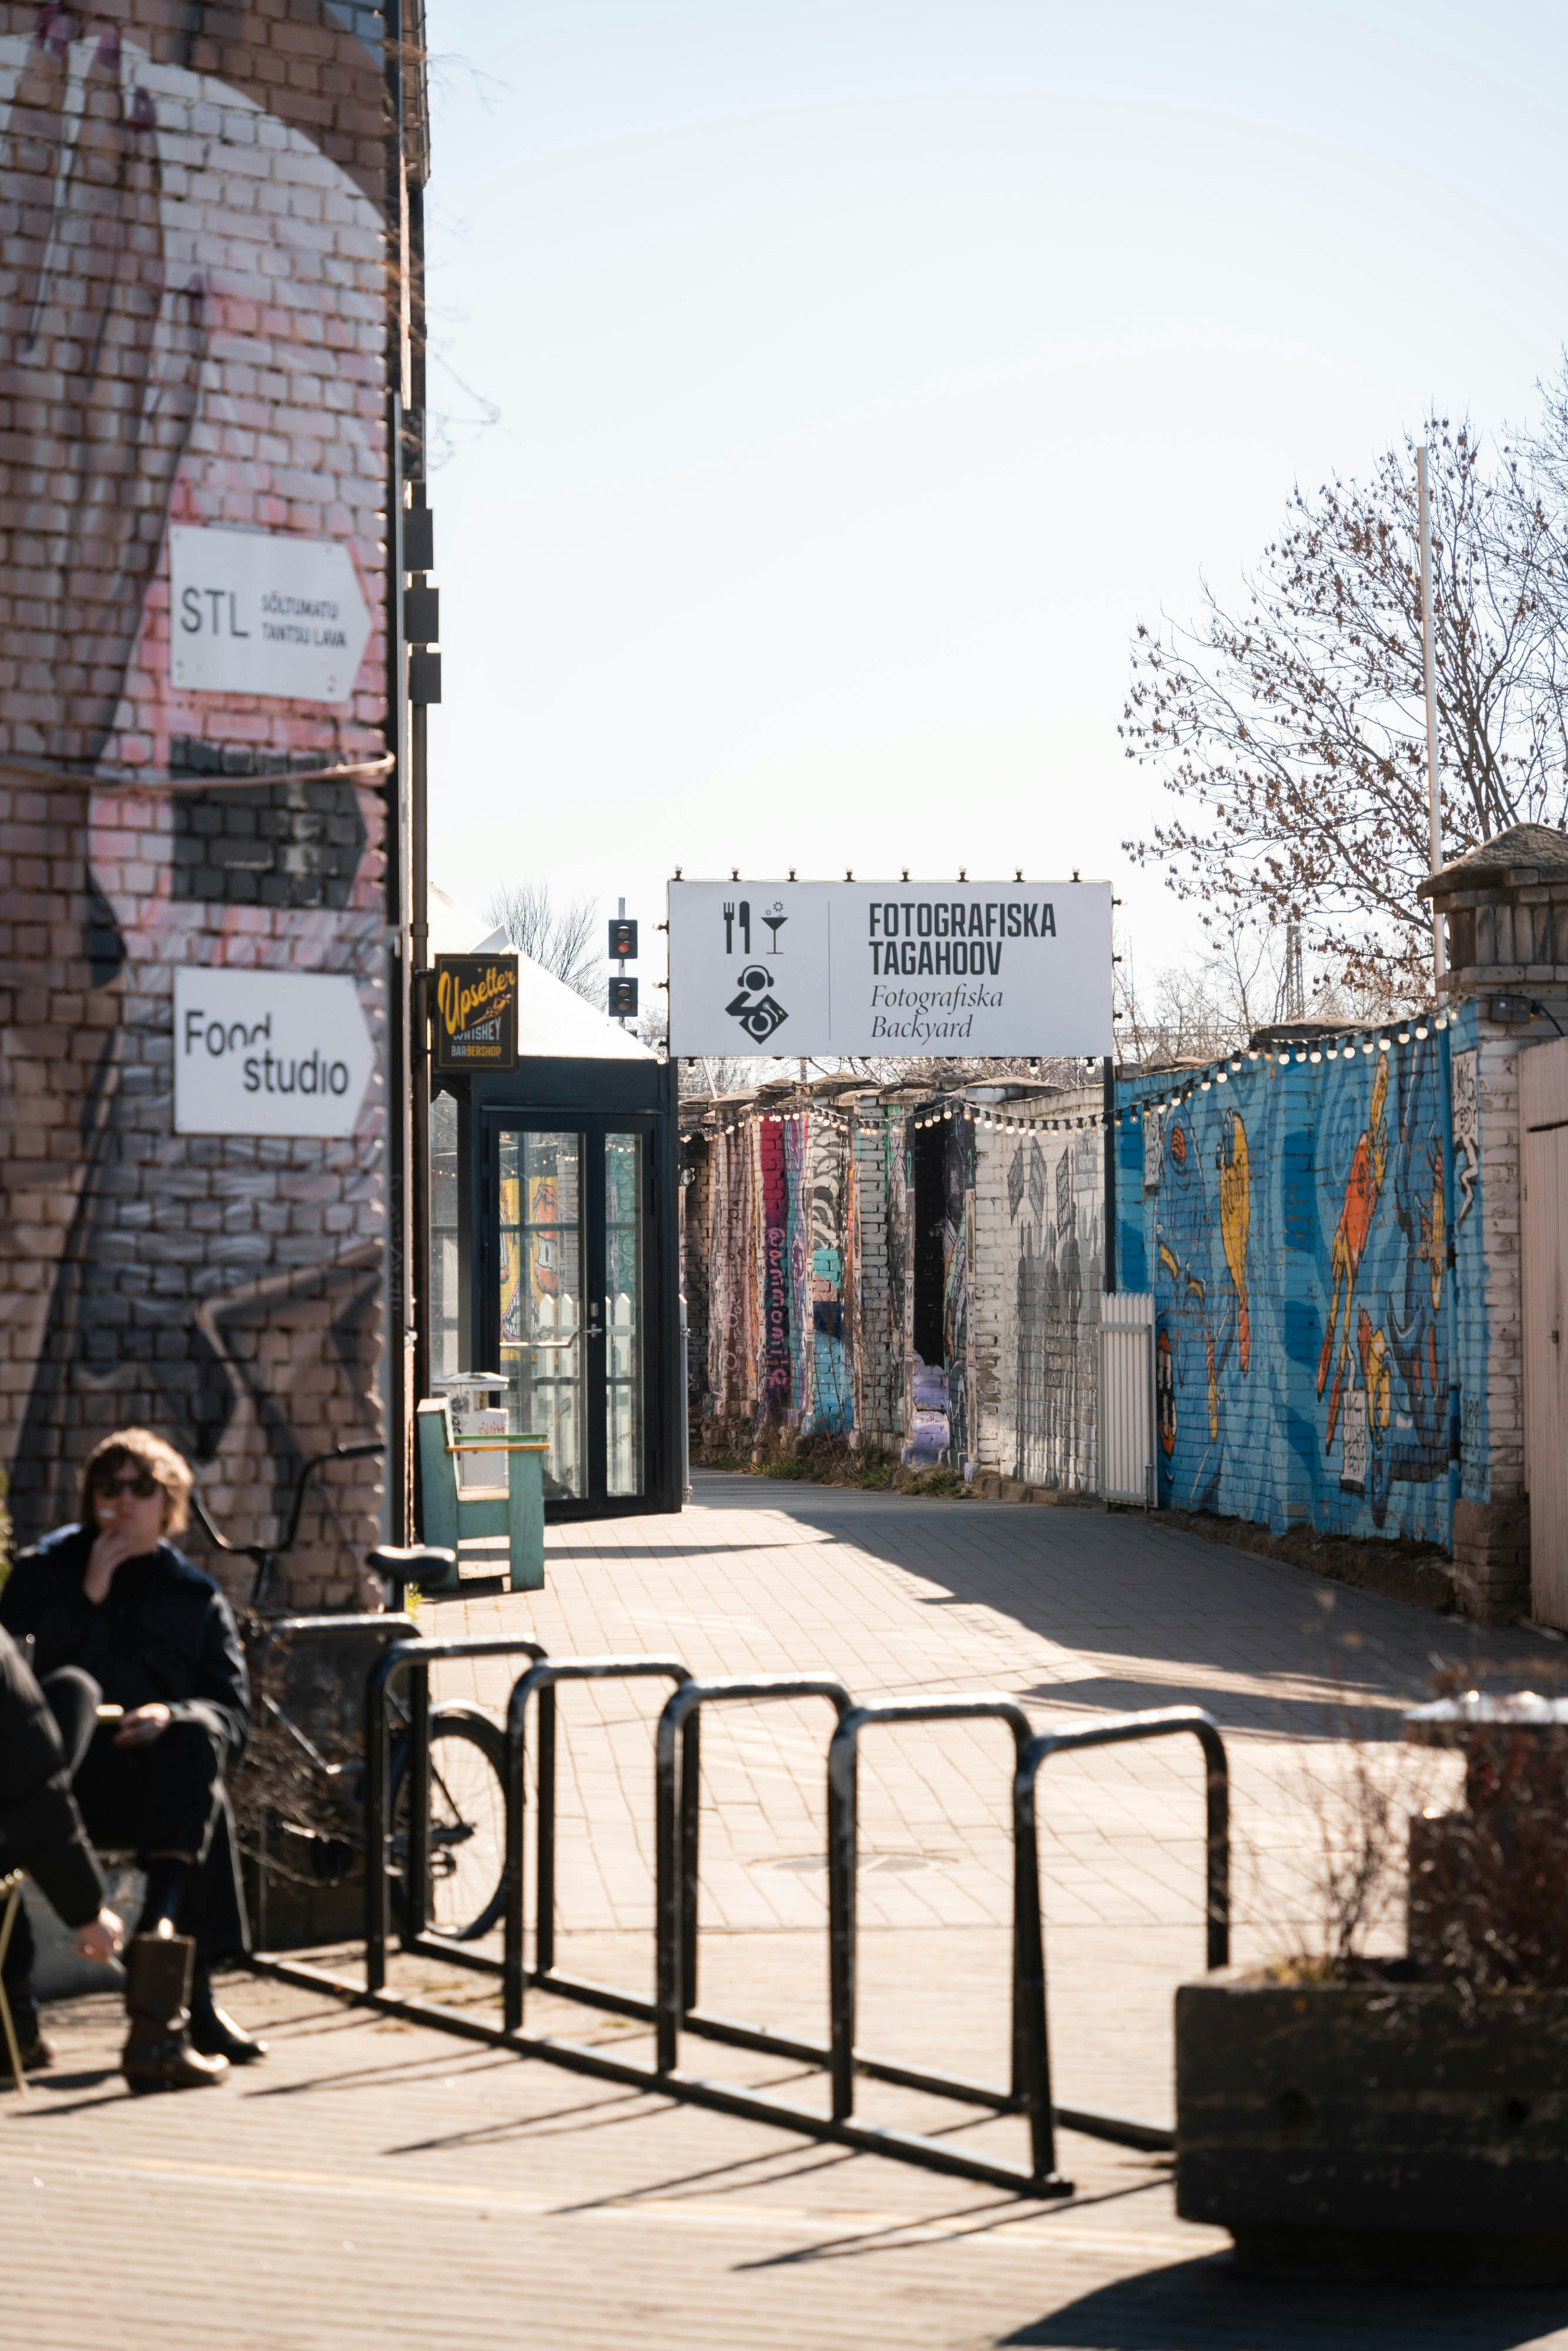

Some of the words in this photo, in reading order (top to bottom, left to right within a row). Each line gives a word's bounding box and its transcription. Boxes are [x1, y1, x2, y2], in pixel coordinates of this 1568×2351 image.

[180, 587, 249, 638] STL
[313, 628, 348, 648] LAVA
[869, 903, 1057, 937] FOTOGRAFISKA
[869, 941, 1002, 976] TAGAHOOV
[437, 966, 516, 1035] Upsetter
[870, 983, 1004, 1015] Fotografiska
[870, 1013, 974, 1046] Backyard
[451, 1045, 502, 1057] BARBERSHOP
[243, 1049, 349, 1096] studio
